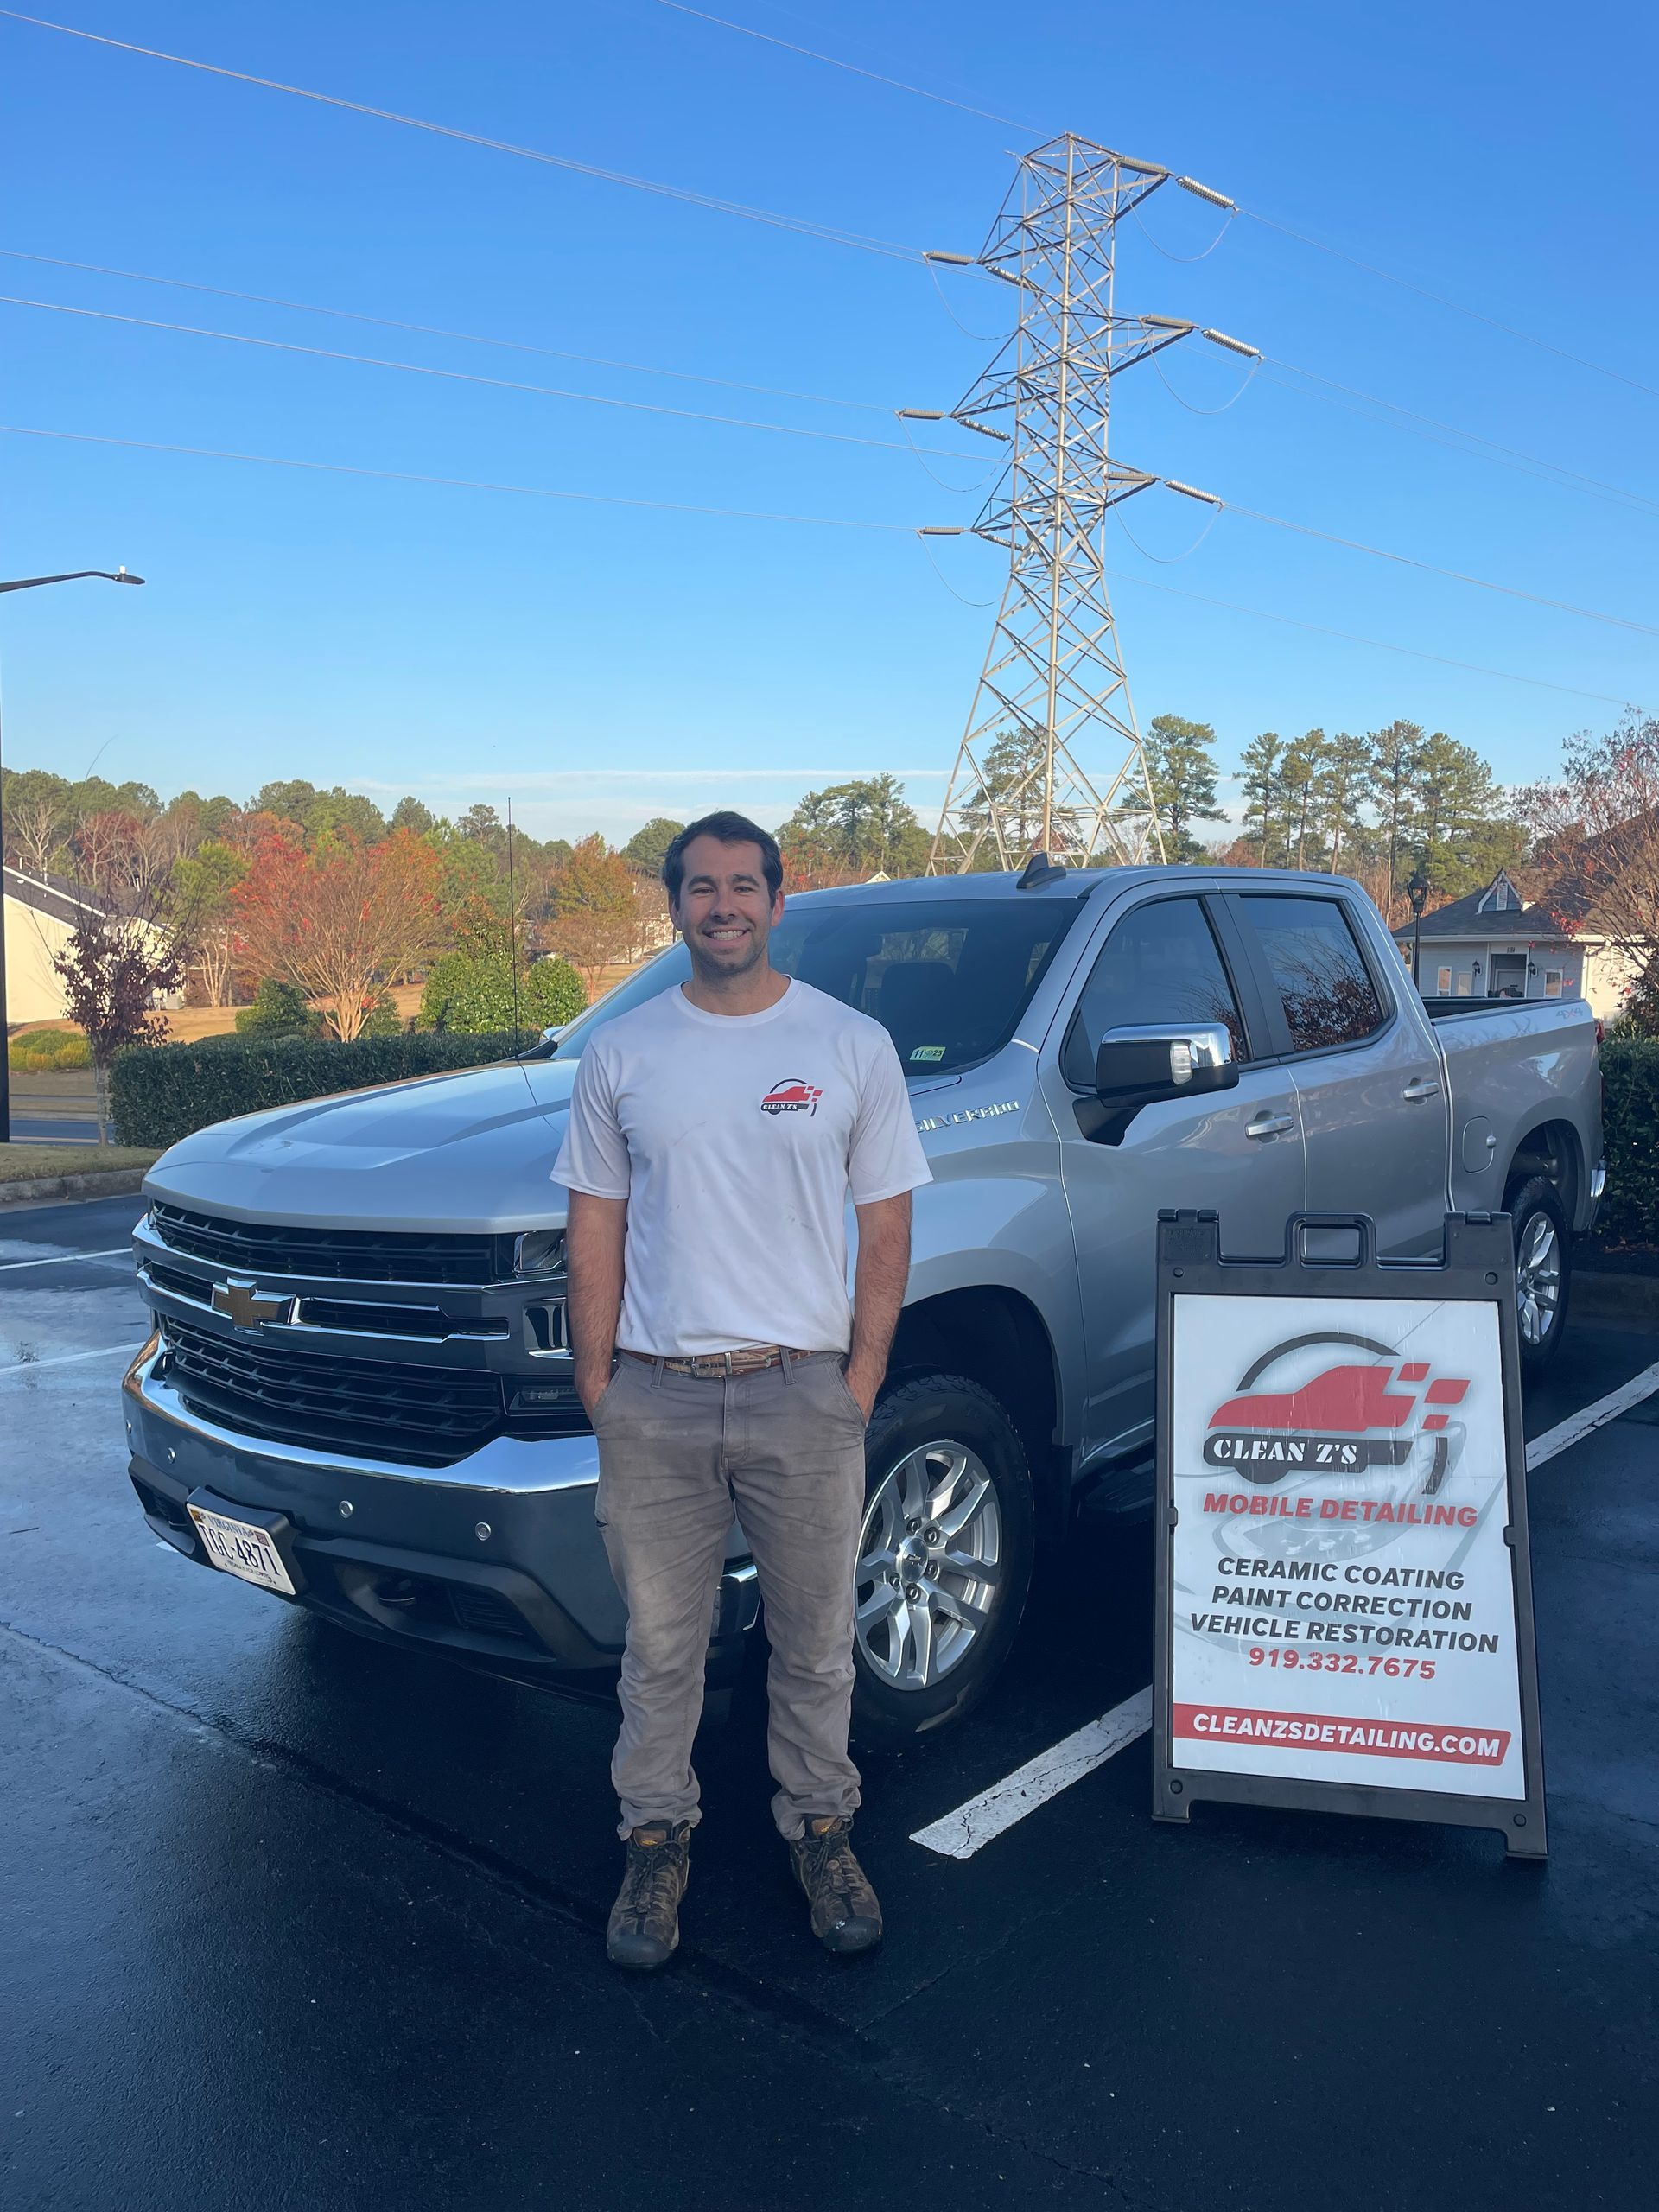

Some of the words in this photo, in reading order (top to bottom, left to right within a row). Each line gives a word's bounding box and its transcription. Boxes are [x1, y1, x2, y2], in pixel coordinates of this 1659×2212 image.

[1213, 1439, 1306, 1462] CLEAN
[1316, 1444, 1357, 1465] Z'S
[207, 1515, 251, 1537] VIRGINIA
[1203, 1493, 1313, 1518] MOBILE
[1319, 1499, 1478, 1527] DETAILING
[1217, 1557, 1338, 1582] CERAMIC
[1344, 1565, 1465, 1590] COATING
[1212, 1586, 1292, 1608] PAINT
[1296, 1592, 1472, 1621] CORRECTION
[1191, 1613, 1300, 1639] VEHICLE
[1306, 1622, 1499, 1653] RESTORATION
[1249, 1647, 1436, 1680] 919.332.7675
[1193, 1713, 1500, 1758] CLEANZSDETAILING.COM
